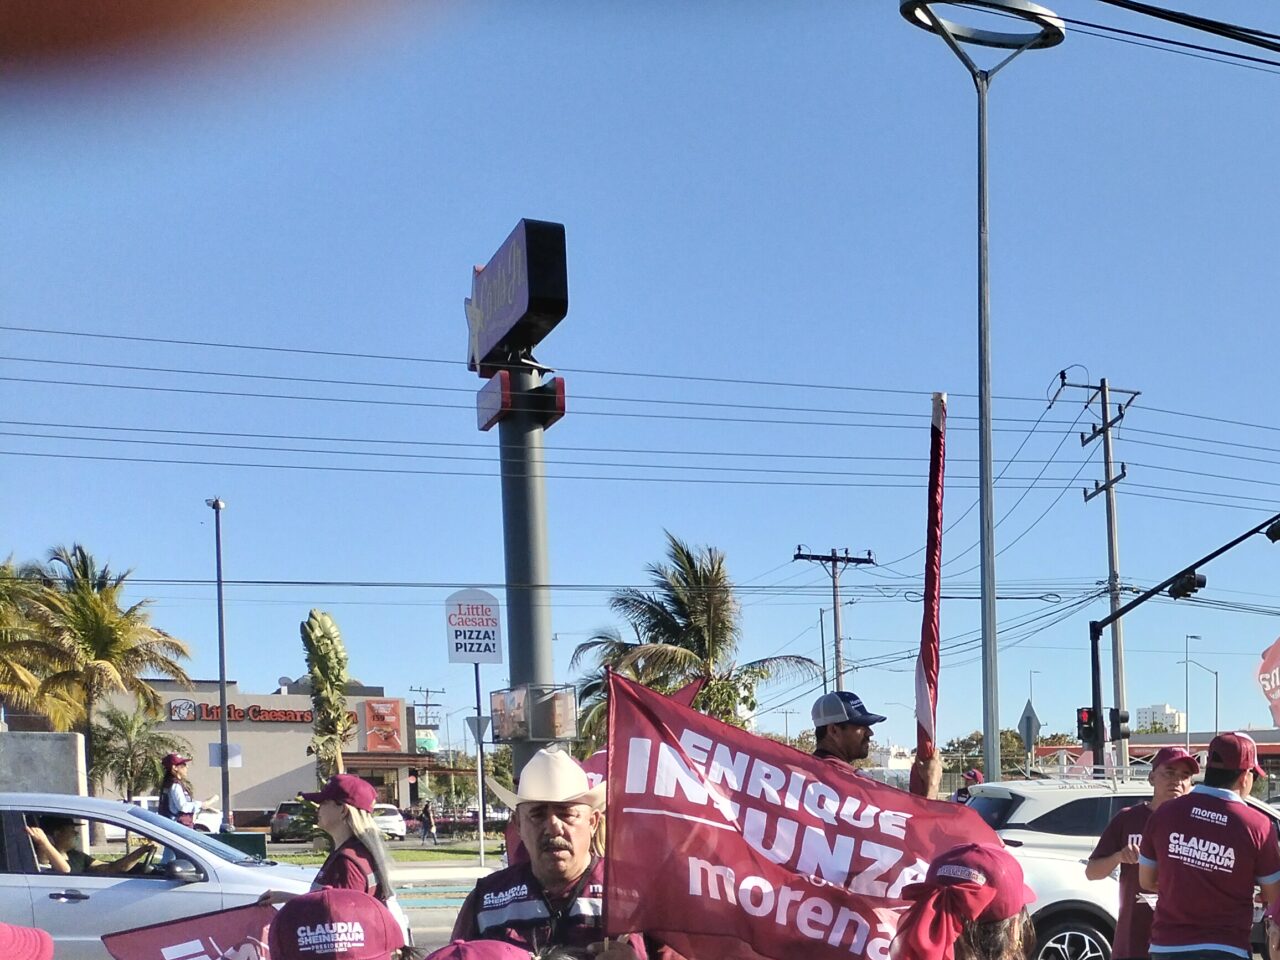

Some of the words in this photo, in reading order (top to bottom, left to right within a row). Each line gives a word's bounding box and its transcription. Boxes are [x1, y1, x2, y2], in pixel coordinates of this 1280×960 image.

[457, 603, 491, 616] Little
[448, 613, 498, 627] Caesars
[454, 629, 496, 641] PIZZA!
[455, 642, 496, 653] PIZZA!
[248, 704, 313, 722] Caesars
[680, 729, 913, 840] ENRIQUE
[625, 737, 932, 899] INUNZA
[1191, 807, 1228, 823] morena
[1169, 832, 1235, 859] CLAUDIA
[1168, 843, 1235, 868] SHEINBAUM
[483, 884, 528, 901] CLAUDIA
[297, 922, 364, 937] CLAUDIA
[297, 933, 364, 946] SHEINBAUM
